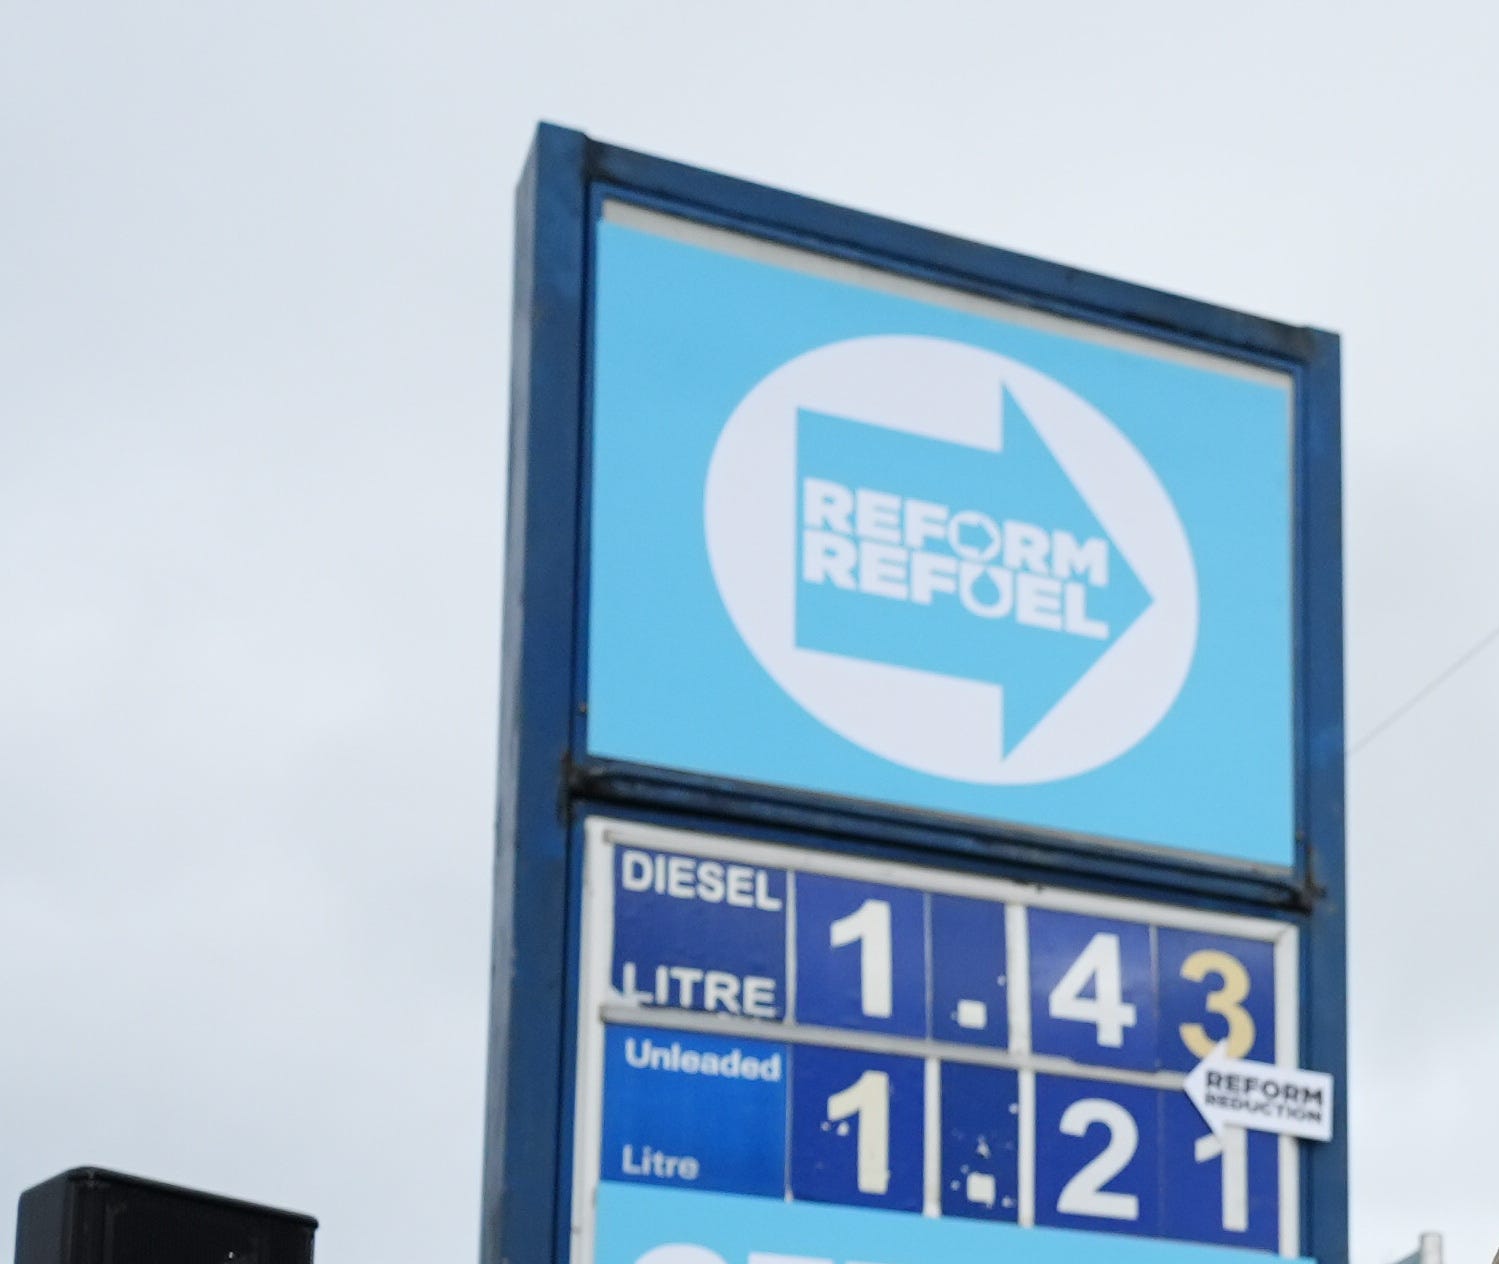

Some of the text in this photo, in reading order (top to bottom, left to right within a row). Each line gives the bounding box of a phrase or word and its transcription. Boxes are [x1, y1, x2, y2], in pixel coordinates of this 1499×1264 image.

[803, 477, 1109, 587] REFORM
[803, 528, 1109, 640] REFUEL
[622, 850, 782, 911] DIESEL
[623, 962, 777, 1017] LITRE
[625, 1038, 782, 1082] Unleaded
[1205, 1093, 1321, 1123] REDUCTION
[1206, 1071, 1322, 1105] REFORM
[622, 1144, 700, 1180] Litre
